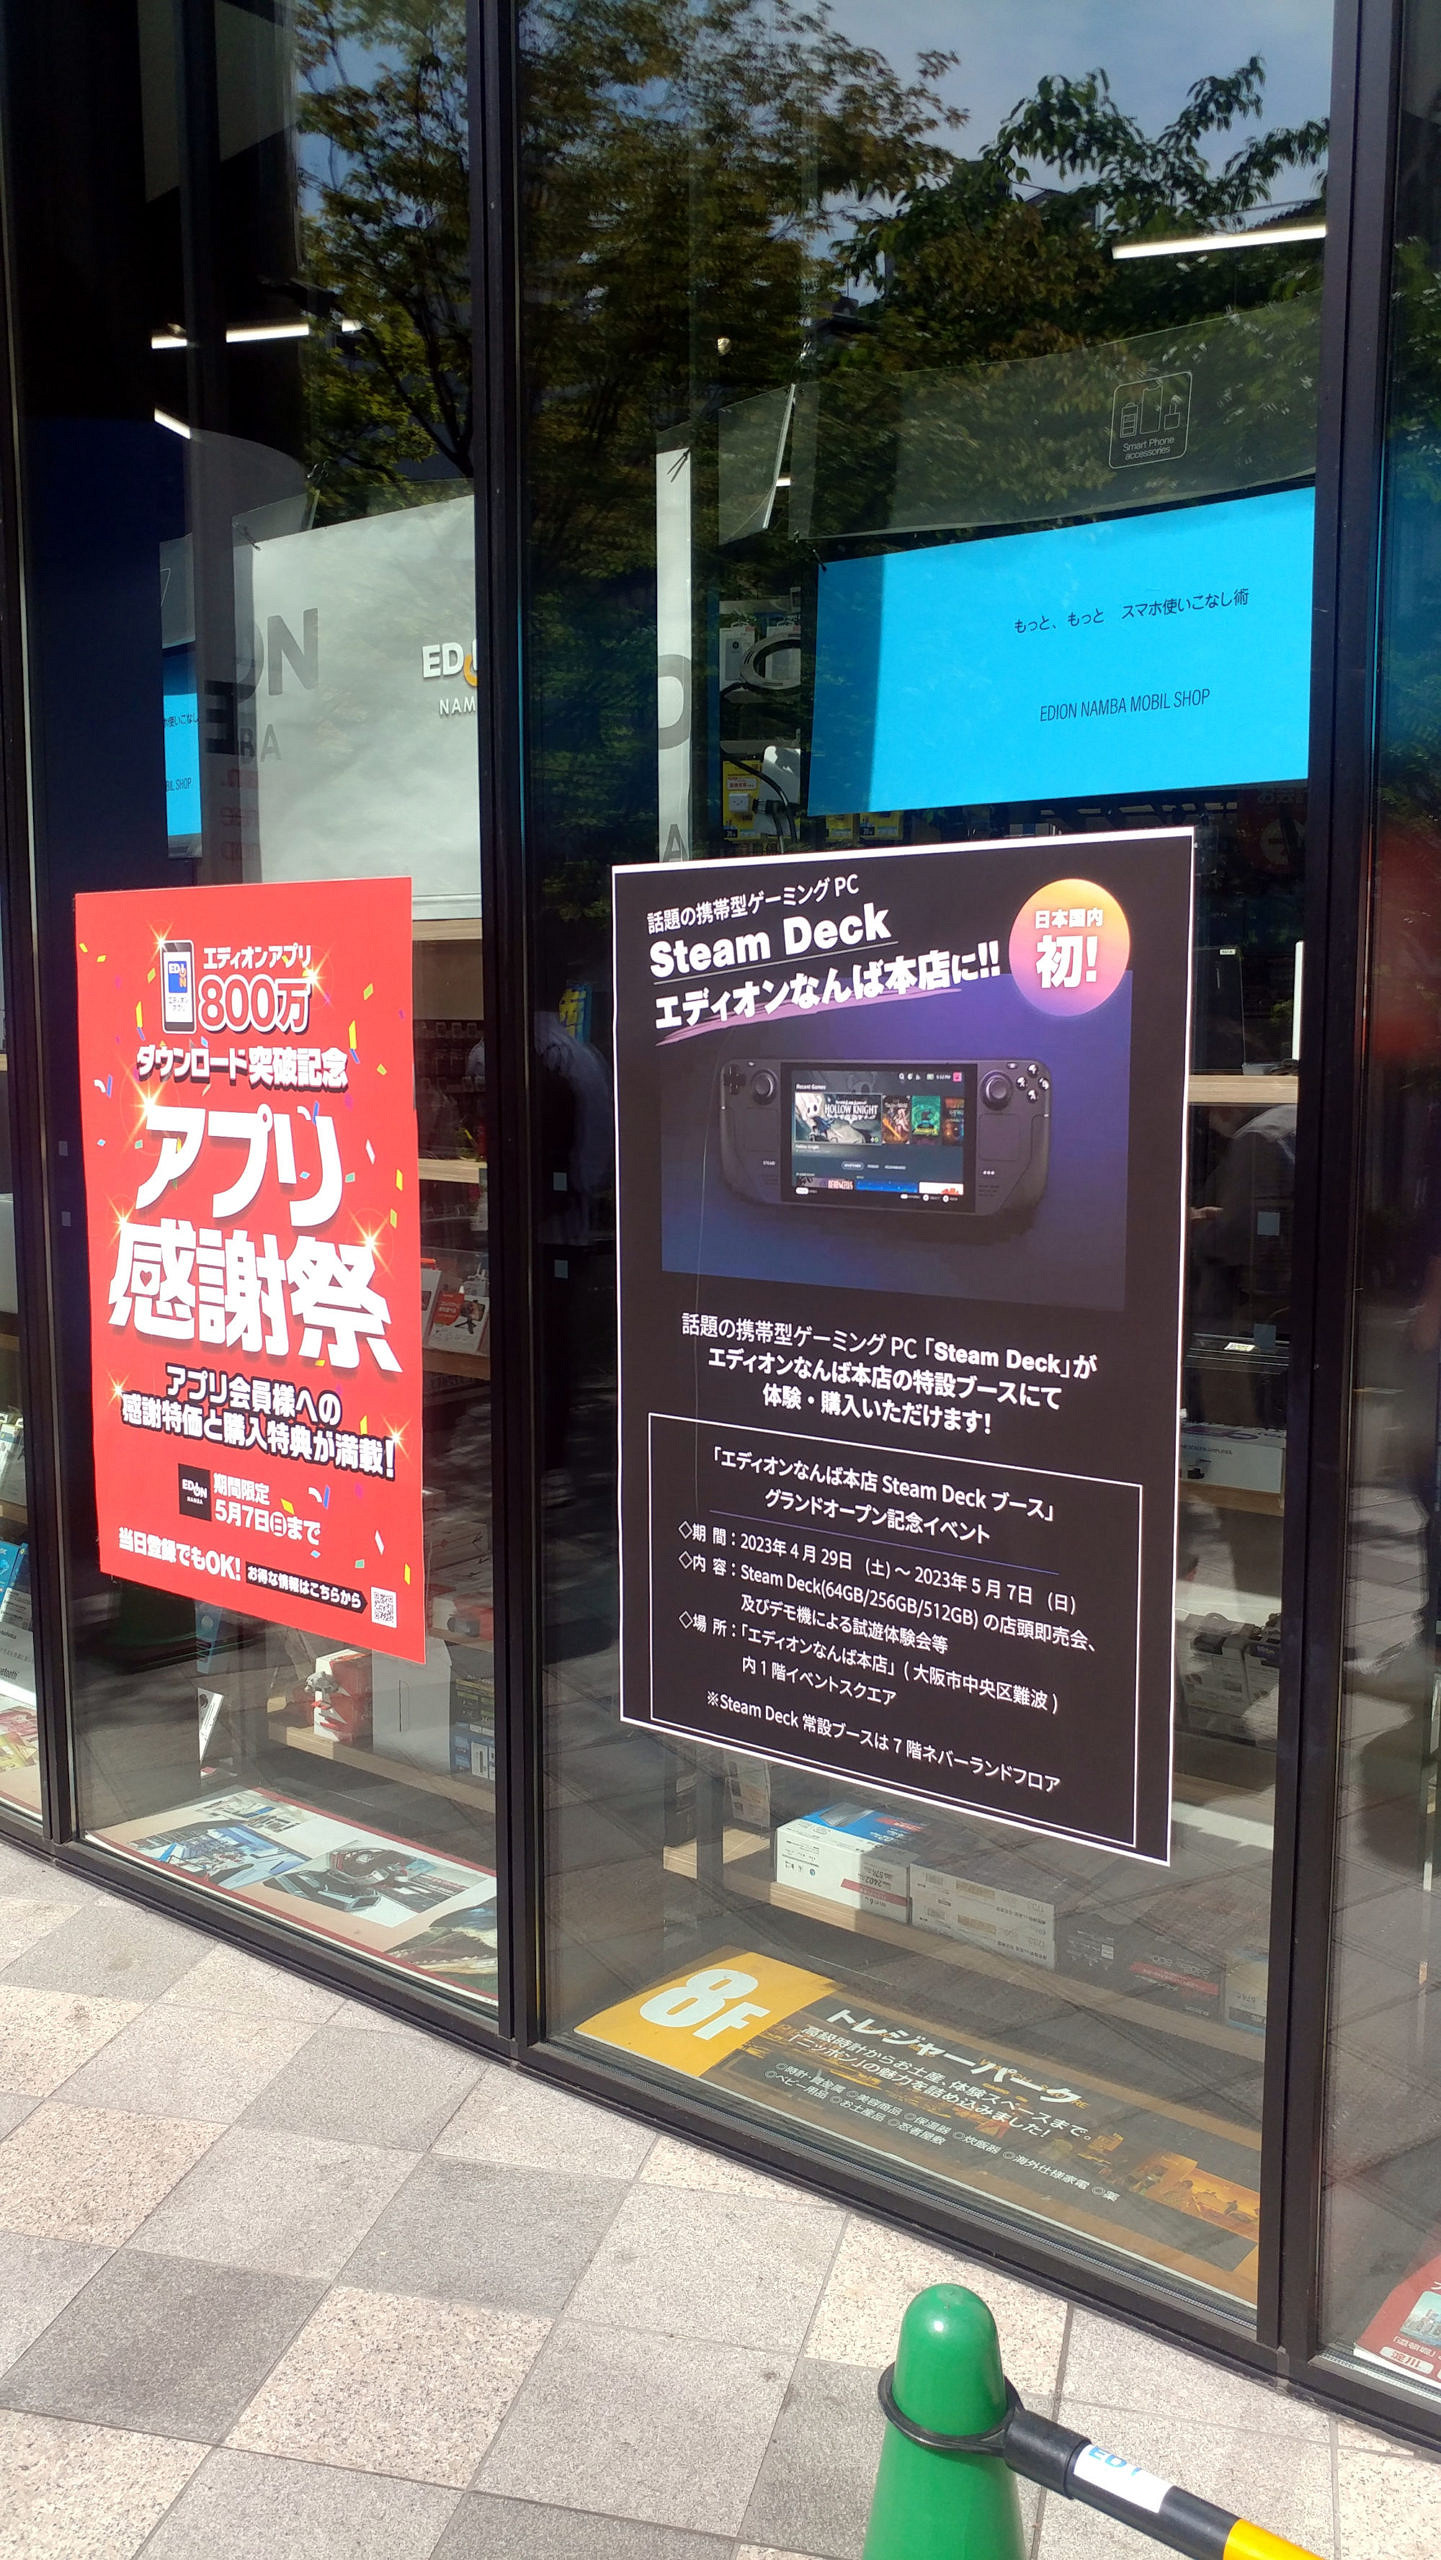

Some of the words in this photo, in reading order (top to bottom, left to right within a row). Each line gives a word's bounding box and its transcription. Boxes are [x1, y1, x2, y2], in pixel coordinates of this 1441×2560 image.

[1123, 441, 1148, 453] Smart
[1149, 436, 1175, 448] Phone
[1124, 446, 1171, 461] accessories
[1014, 614, 1057, 634] もっと、
[1067, 608, 1105, 627] もっと
[1121, 588, 1250, 620] スマホ使いこなし術
[1040, 700, 1078, 722] EDION
[1081, 697, 1127, 717] NAMBA
[1130, 692, 1171, 713] MOBIL
[1173, 687, 1211, 709] SHOP
[176, 776, 192, 792] SHOP
[647, 877, 830, 934] 話題の携帯型ゲーミング
[834, 874, 860, 897] PC
[1034, 907, 1104, 930] 日本国内
[203, 943, 311, 970] エディオンアプリ
[650, 931, 771, 978] Steam
[783, 902, 892, 955] Deck
[1036, 935, 1099, 989] 初!
[199, 974, 311, 1033] 800万
[136, 1044, 348, 1090] ダウンロード突破記念
[824, 1104, 852, 1115] HOLLOW
[853, 1105, 879, 1115] KNIGHT
[135, 1104, 343, 1227] アプリ
[107, 1217, 403, 1372] 感謝祭
[681, 1312, 886, 1356] 話題の携帯型ゲーミング
[890, 1336, 918, 1360] PC
[165, 1363, 342, 1427] アプリ会員様への
[708, 1347, 1062, 1410] エディオンなんば本店の特設ブースにて
[213, 1472, 270, 1506] 期間限定
[882, 1474, 937, 1502] Steam
[941, 1484, 987, 1510] Deck
[766, 1488, 990, 1544] グランドオープン記念イベント
[247, 1565, 362, 1610] お得な情報はこちらから
[741, 1593, 949, 1655] 及びデモ機による試遊体験会等
[765, 1705, 799, 1729] Deck
[640, 1968, 771, 2041] 8F
[826, 2008, 1083, 2103] トレジャーパーク
[800, 2024, 1092, 2141] 高級時計からお土産、体験スペースまで。
